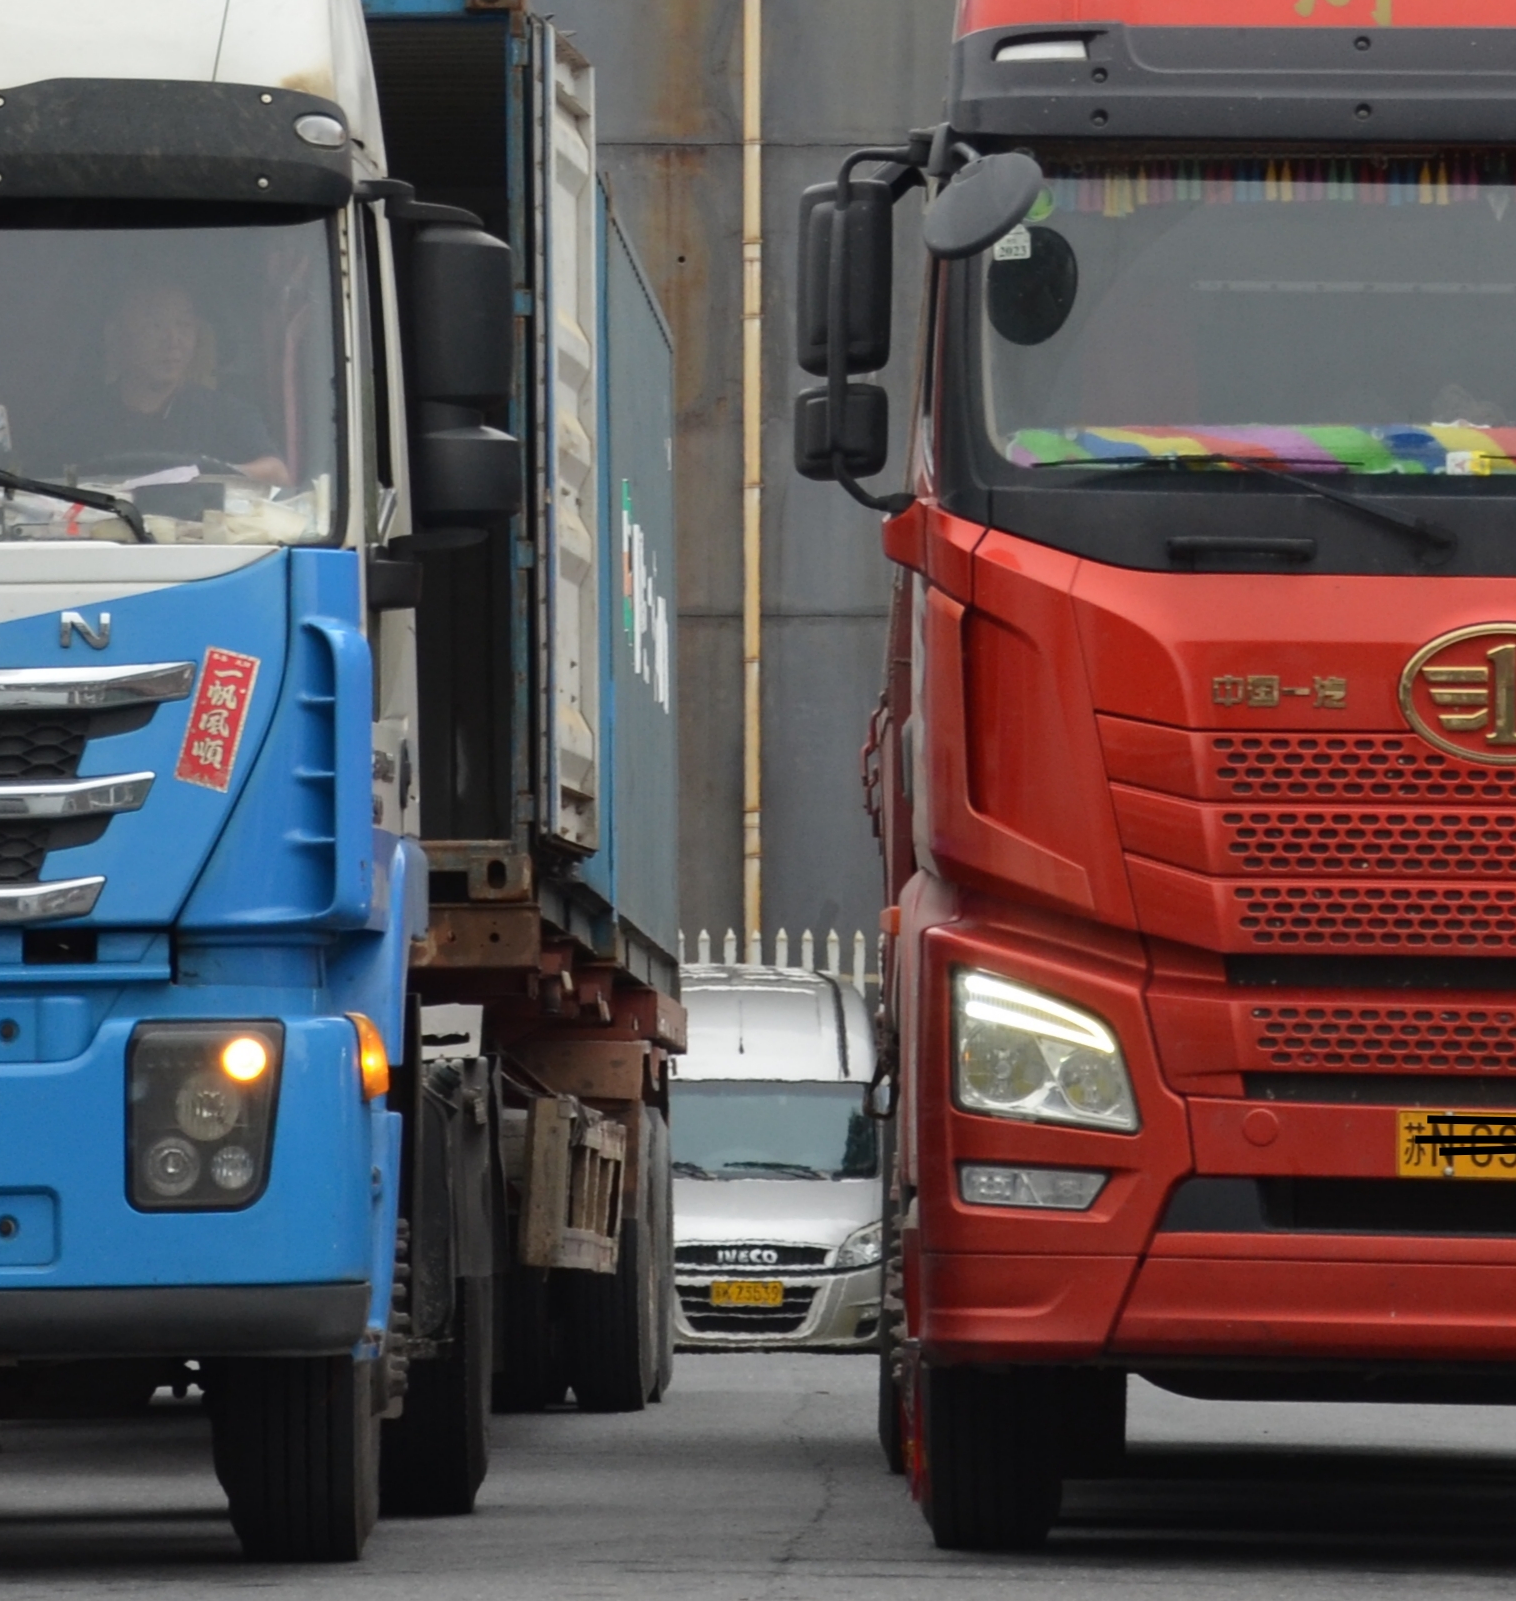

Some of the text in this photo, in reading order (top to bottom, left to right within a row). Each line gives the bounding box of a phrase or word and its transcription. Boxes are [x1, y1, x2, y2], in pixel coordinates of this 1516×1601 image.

[998, 245, 1028, 258] 2023
[1212, 674, 1348, 709] 中国一汽
[716, 1248, 778, 1264] IVECO
